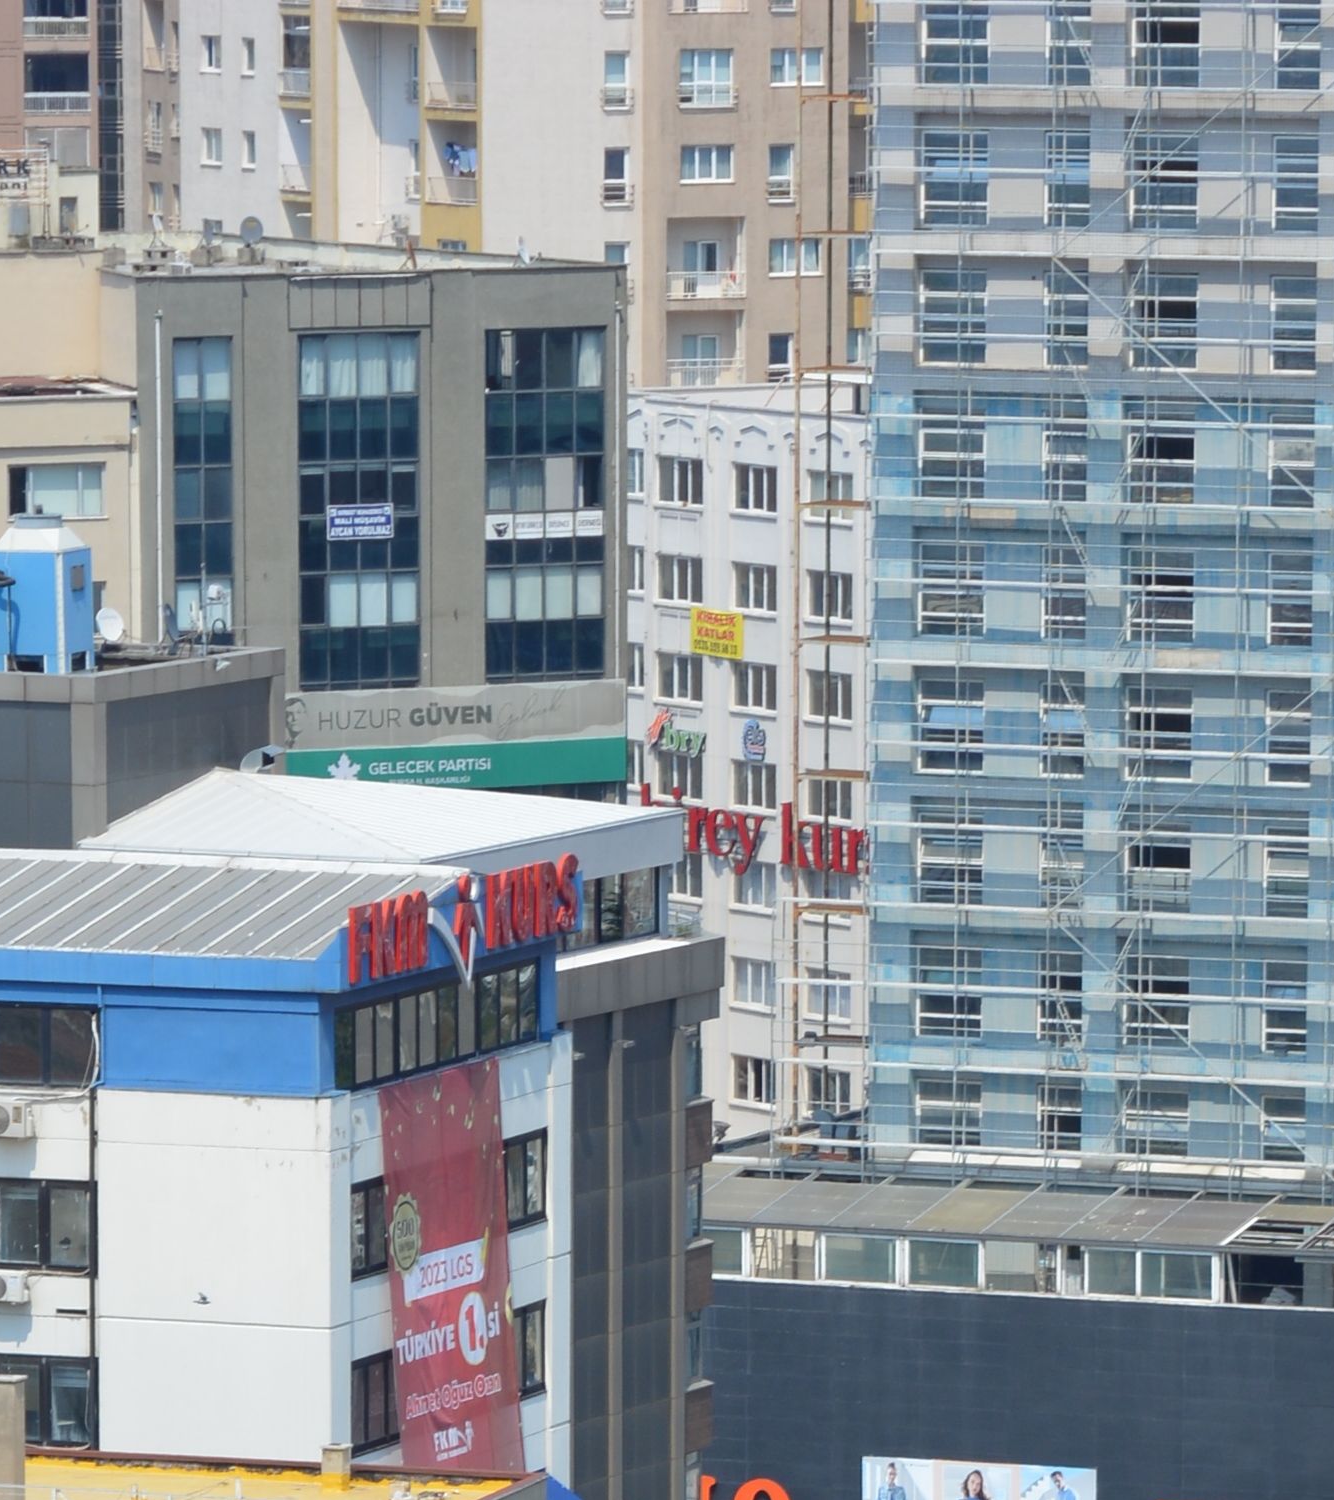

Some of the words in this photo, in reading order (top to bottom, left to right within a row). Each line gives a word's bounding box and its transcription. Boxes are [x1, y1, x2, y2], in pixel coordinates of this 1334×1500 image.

[318, 708, 401, 731] HUZUR
[408, 703, 493, 727] GÜVEN
[368, 760, 436, 775] GELECEK
[438, 757, 492, 773] PARTİSİ
[348, 889, 428, 985] FKM
[485, 852, 580, 950] KURS
[419, 1262, 448, 1289] 2023
[450, 1253, 475, 1281] LGS
[397, 1320, 455, 1365] TÜRKİYE
